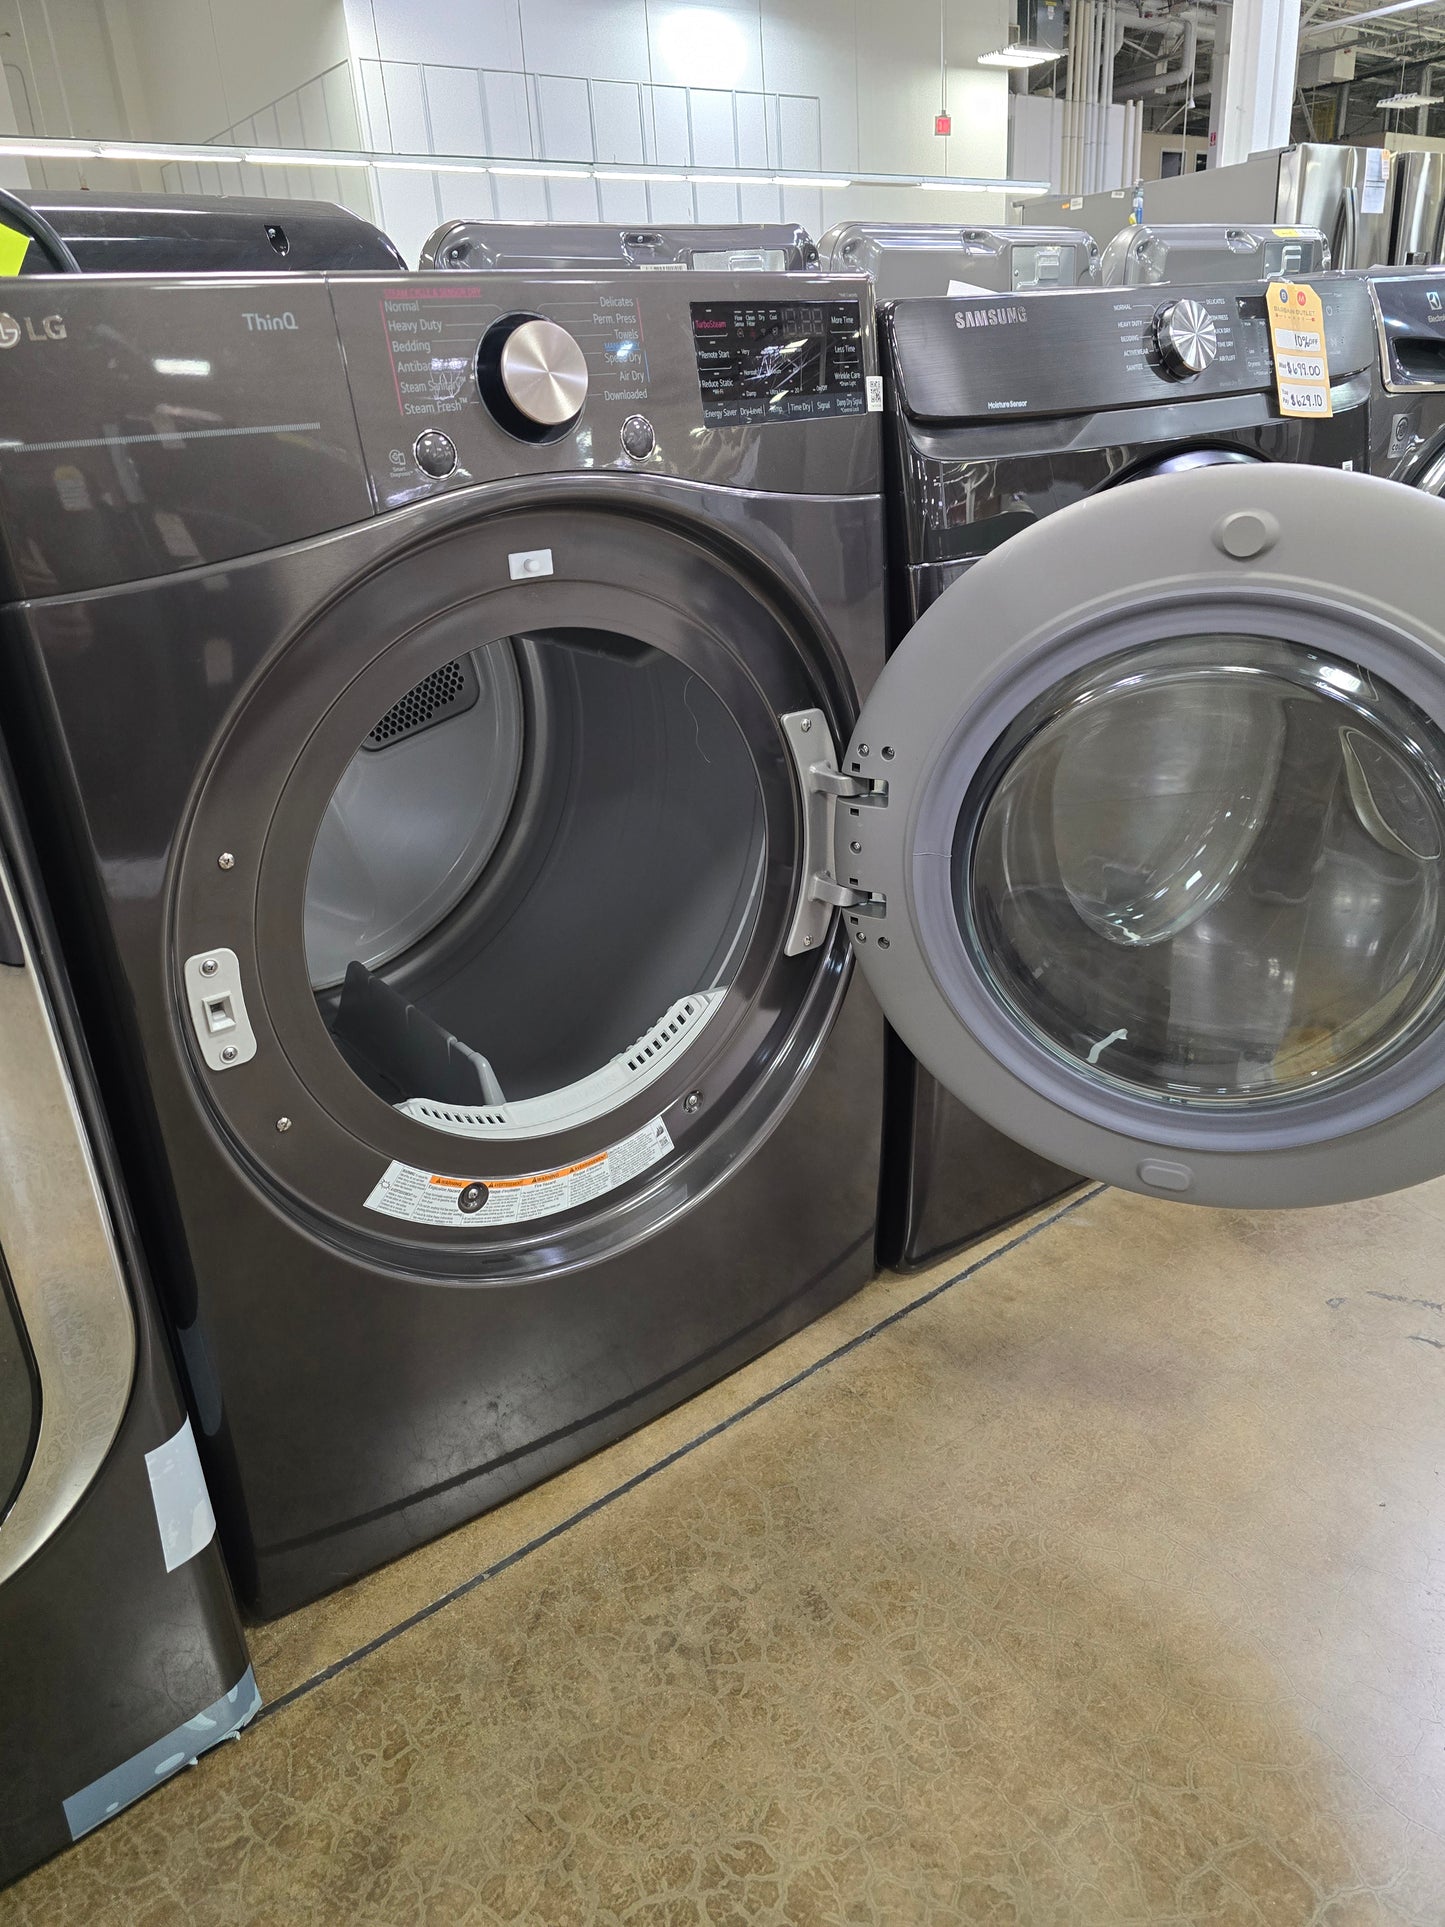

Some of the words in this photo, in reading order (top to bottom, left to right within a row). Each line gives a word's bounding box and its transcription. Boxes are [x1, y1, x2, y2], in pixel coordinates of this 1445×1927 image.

[384, 300, 419, 312] Normal
[600, 296, 633, 307] Delicates
[242, 312, 299, 330] ThinQ
[593, 313, 615, 325] Perm.
[616, 313, 636, 324] Press
[843, 315, 854, 324] Time
[954, 306, 1028, 329] SAMSUNG
[24, 314, 68, 341] LG
[387, 320, 417, 334] Heavy
[419, 319, 442, 333] Duty
[695, 320, 727, 330] TurboSteam
[614, 329, 639, 340] Towels
[392, 340, 431, 354] Bedding
[845, 344, 855, 353] Time
[630, 353, 642, 364] Dry
[718, 350, 730, 359] Start
[1286, 361, 1320, 376] $699.00
[619, 371, 631, 382] Air
[632, 370, 645, 383] Dry
[400, 381, 426, 393] Steam
[701, 380, 719, 388] Reduce
[720, 379, 733, 388] Static
[604, 388, 648, 401] Downloaded
[1290, 394, 1323, 407] $629.10
[405, 402, 434, 415] Steam
[791, 403, 802, 411] Time
[803, 403, 811, 412] Dry
[988, 401, 1009, 410] Moisture
[1010, 400, 1028, 408] Sensor
[705, 409, 722, 419] Energy
[723, 408, 737, 417] Saver
